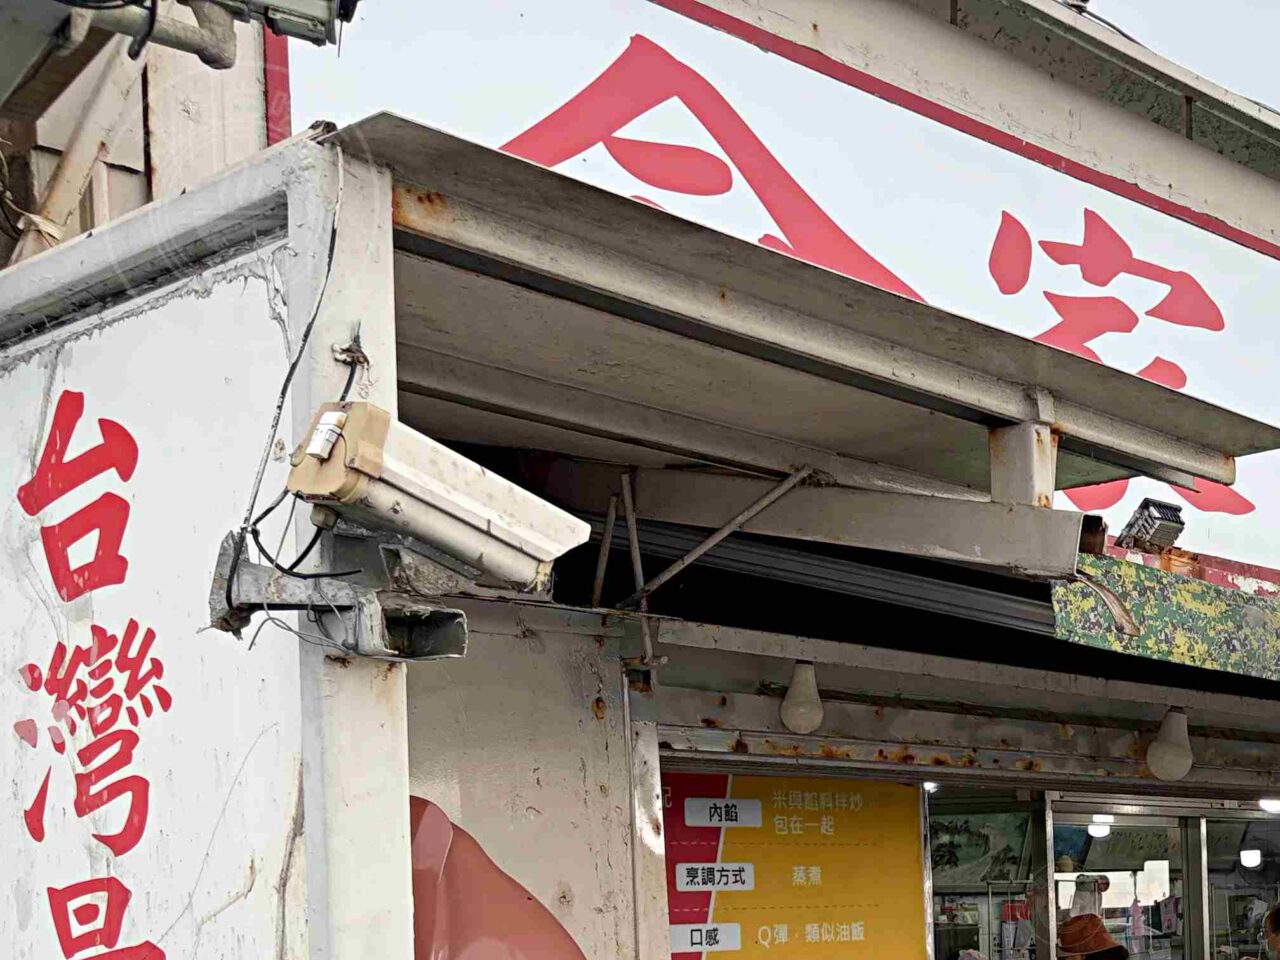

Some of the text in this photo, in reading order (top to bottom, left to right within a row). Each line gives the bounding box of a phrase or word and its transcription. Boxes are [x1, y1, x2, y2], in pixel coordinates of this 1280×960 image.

[708, 803, 738, 823] 內餡
[773, 815, 834, 835] 包在一起
[685, 866, 746, 887] 烹調方式
[792, 866, 822, 886] 蒸煮
[690, 928, 720, 947] 口感
